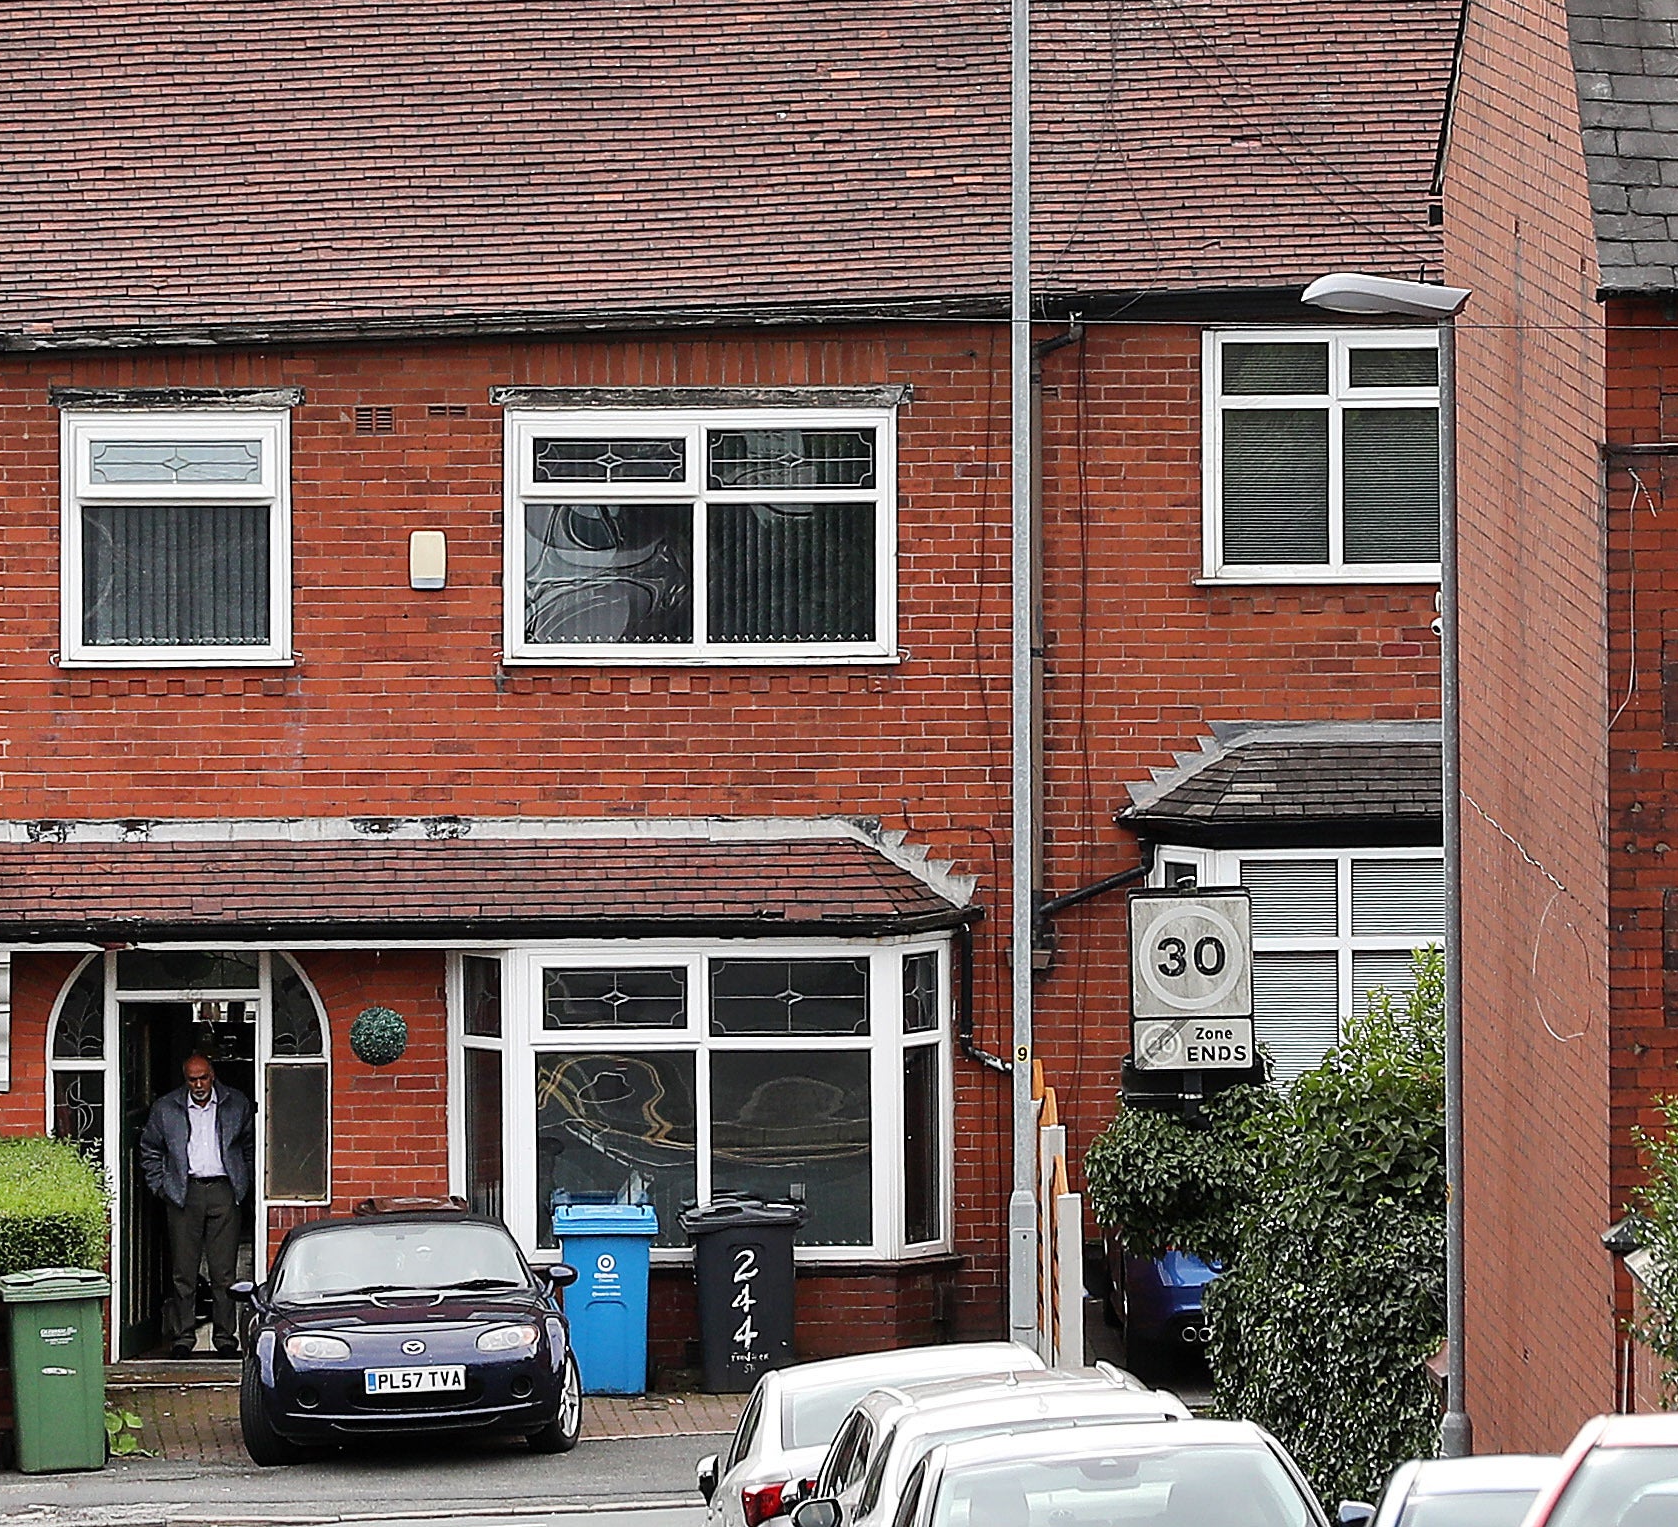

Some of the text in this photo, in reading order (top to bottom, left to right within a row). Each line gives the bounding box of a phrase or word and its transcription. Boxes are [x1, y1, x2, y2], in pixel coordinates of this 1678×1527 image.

[1157, 936, 1226, 977] 30
[1195, 1027, 1233, 1040] Zone
[1017, 1046, 1028, 1062] 9
[1187, 1045, 1247, 1062] ENDS
[378, 1370, 461, 1390] PL57 TVA
